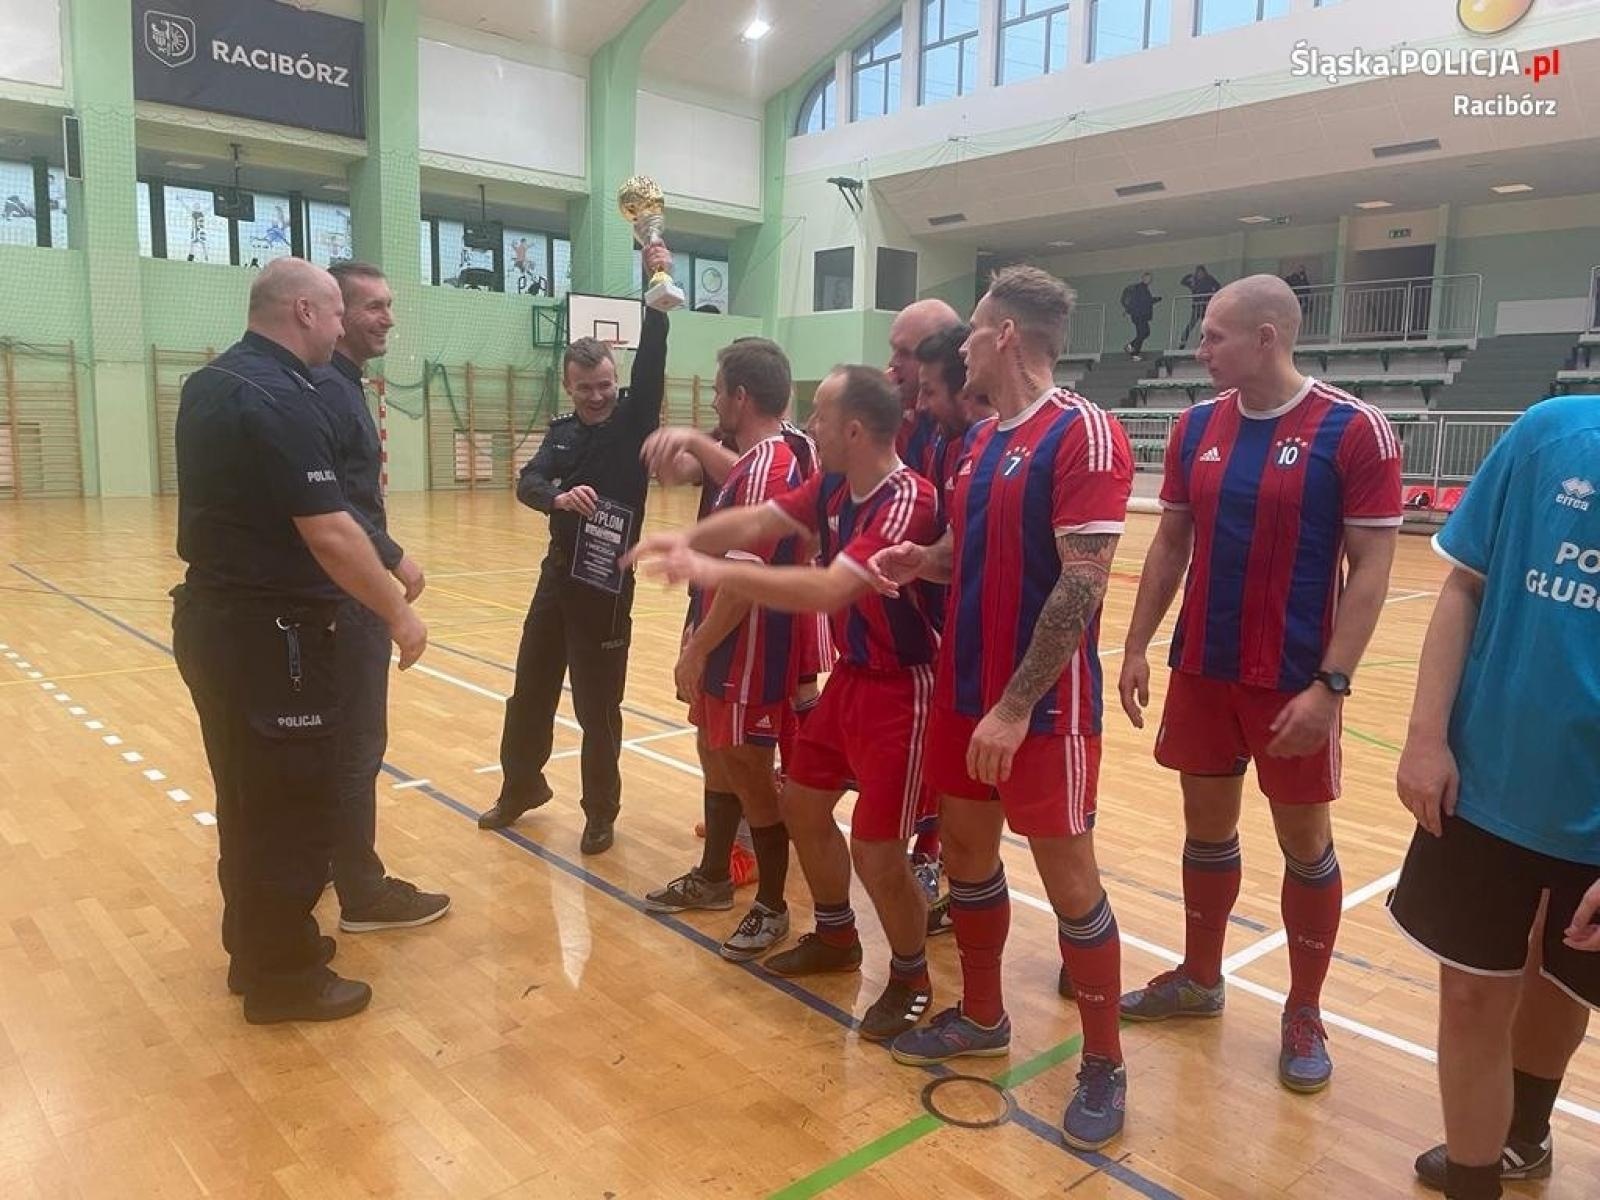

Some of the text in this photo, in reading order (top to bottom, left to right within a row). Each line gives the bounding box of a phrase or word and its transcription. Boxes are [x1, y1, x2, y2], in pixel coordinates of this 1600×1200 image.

[211, 39, 349, 87] RACIBÓRZ
[1004, 456, 1022, 476] 7
[1278, 446, 1298, 465] 10
[589, 510, 625, 532] YPLOM
[1526, 568, 1600, 613] GŁUB
[277, 714, 323, 728] POLICJA
